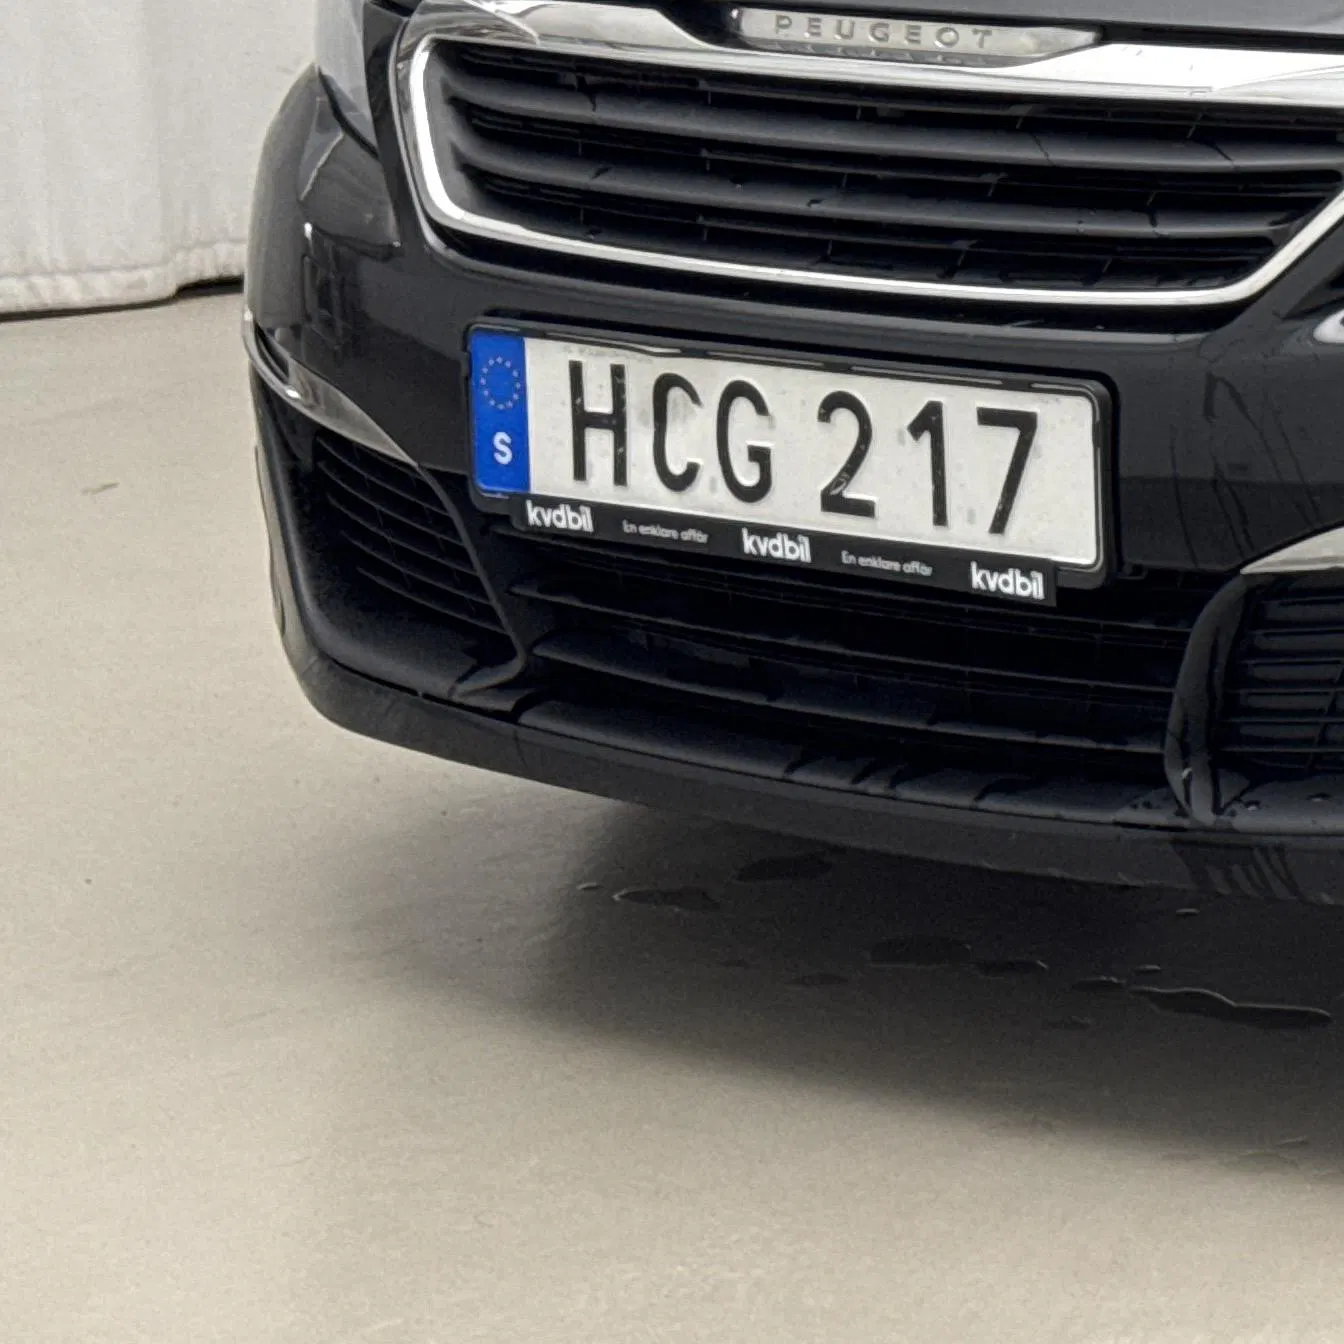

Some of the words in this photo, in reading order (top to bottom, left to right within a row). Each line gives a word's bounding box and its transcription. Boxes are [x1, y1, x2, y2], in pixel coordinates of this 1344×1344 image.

[775, 14, 993, 49] PEUGEOT
[493, 431, 513, 465] S
[567, 359, 773, 504] HCG
[817, 390, 1038, 536] 217
[526, 500, 594, 533] kvdbil
[742, 527, 812, 563] kvdbil
[970, 561, 1045, 600] kvdbil
